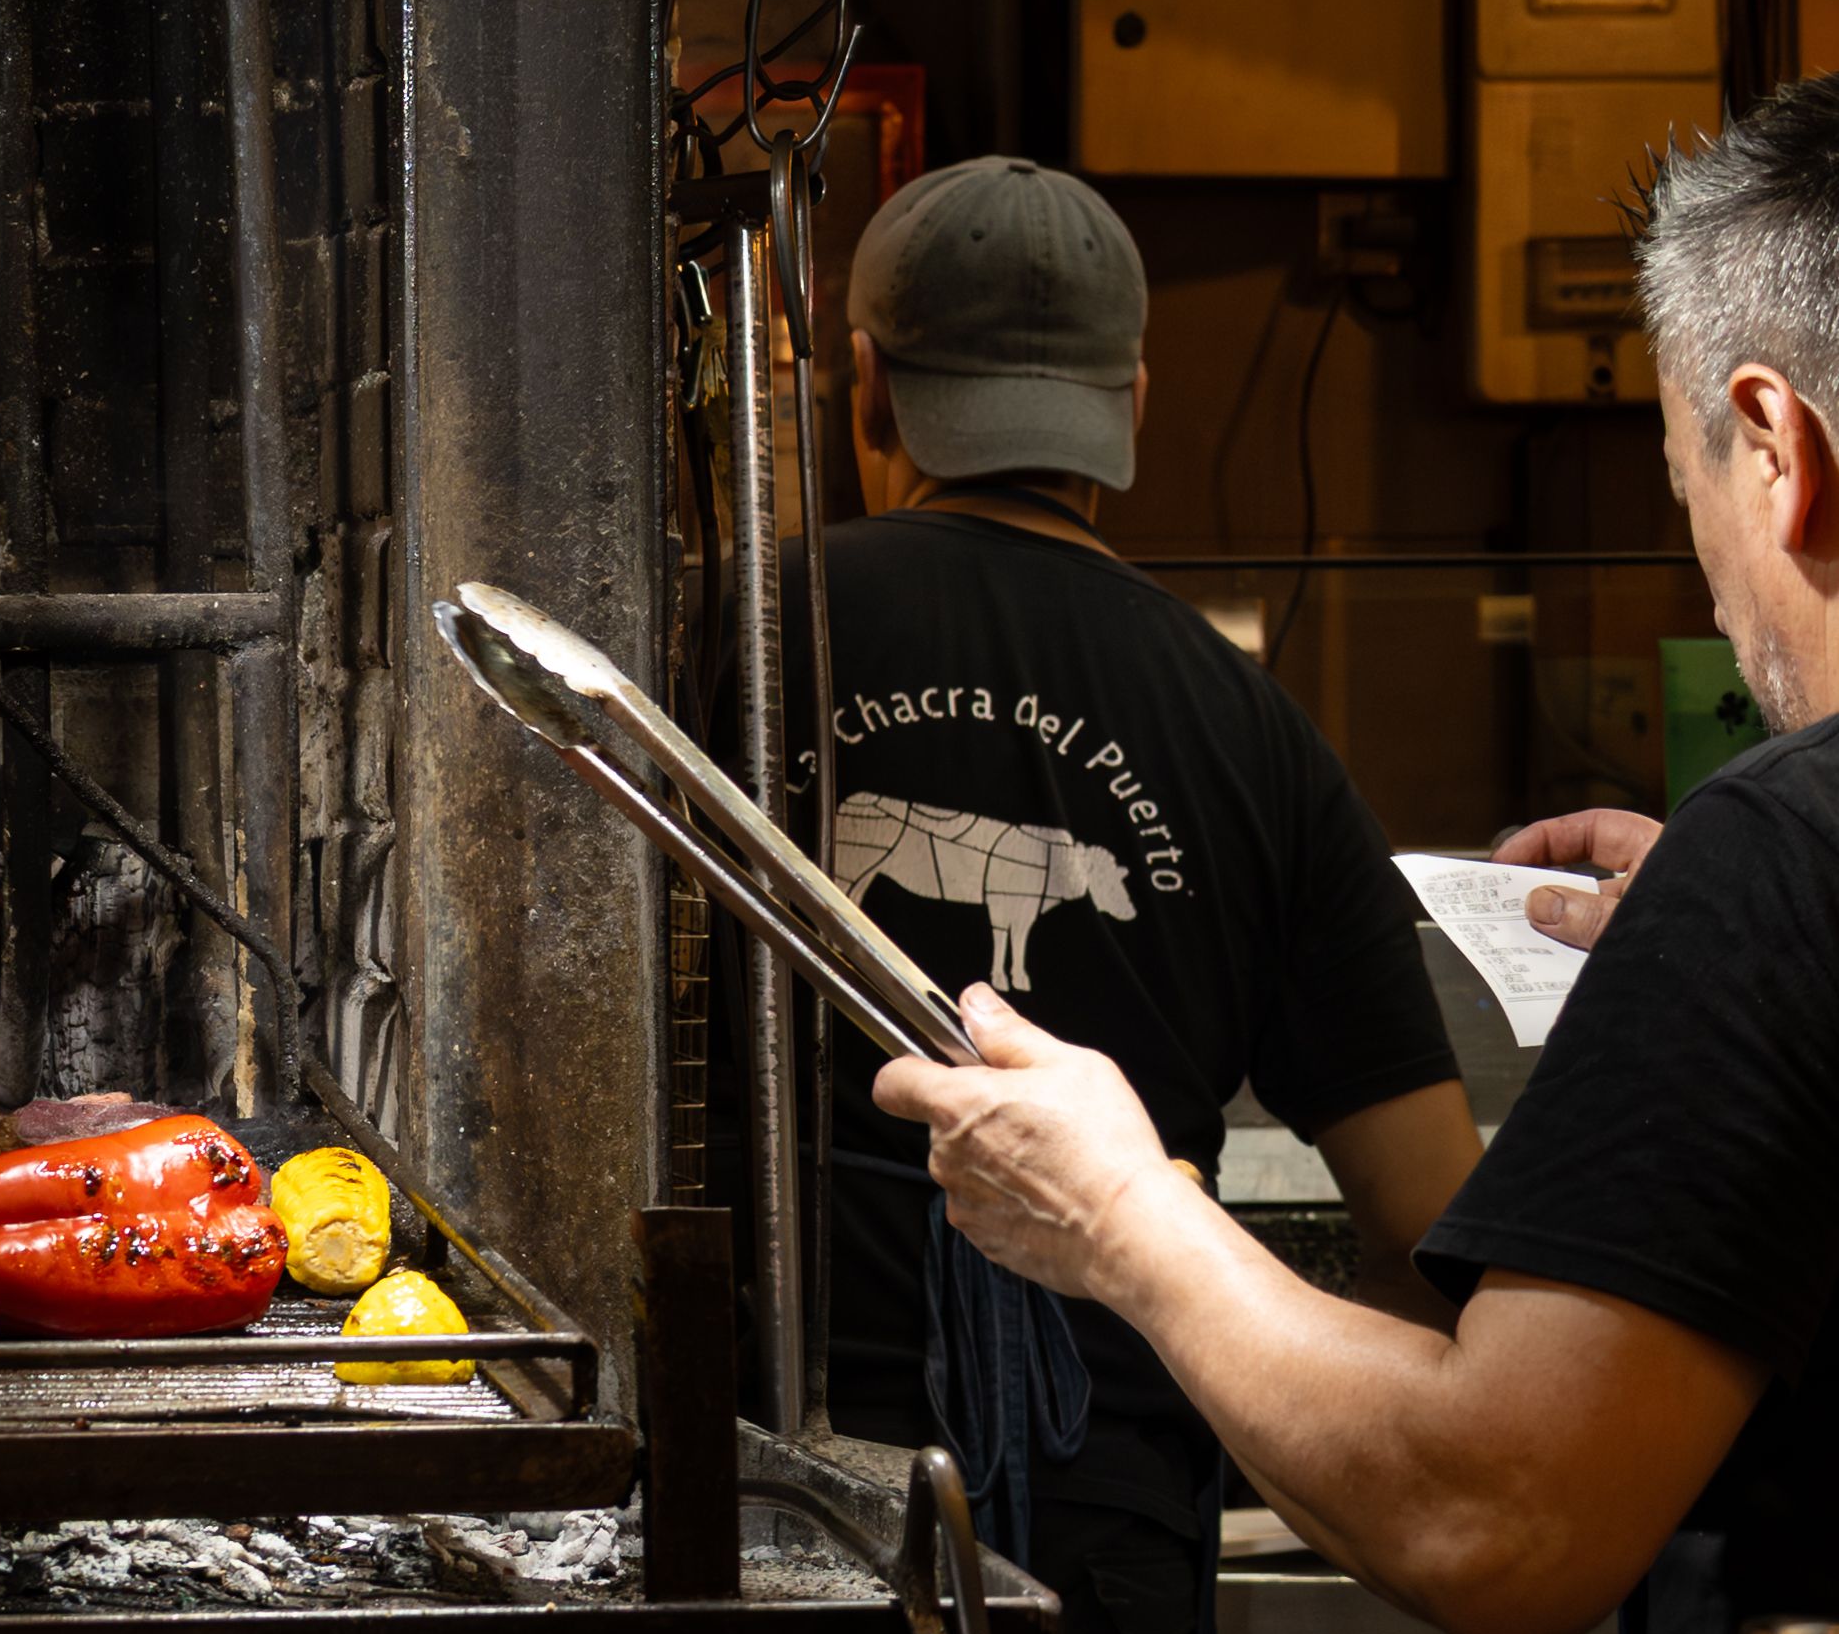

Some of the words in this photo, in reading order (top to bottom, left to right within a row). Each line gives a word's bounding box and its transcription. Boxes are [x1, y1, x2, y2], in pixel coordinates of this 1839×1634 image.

[831, 686, 995, 745] Chacra
[1012, 693, 1085, 756] del
[1083, 740, 1184, 893] Puerto
